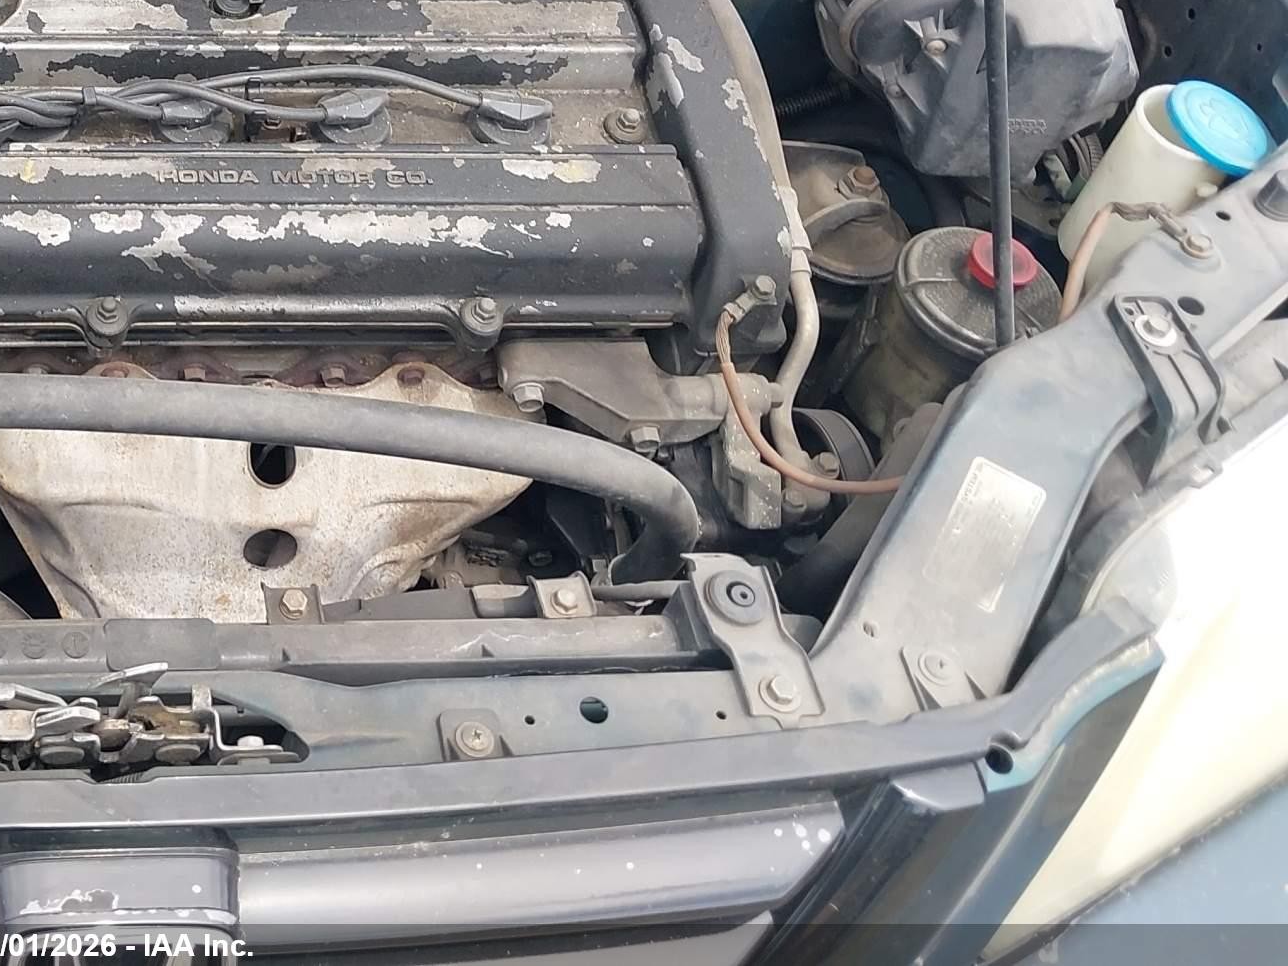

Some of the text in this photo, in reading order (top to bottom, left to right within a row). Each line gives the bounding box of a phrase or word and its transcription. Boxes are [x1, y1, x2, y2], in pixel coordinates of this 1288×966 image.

[156, 169, 434, 185] HONDA MOTOR CO.
